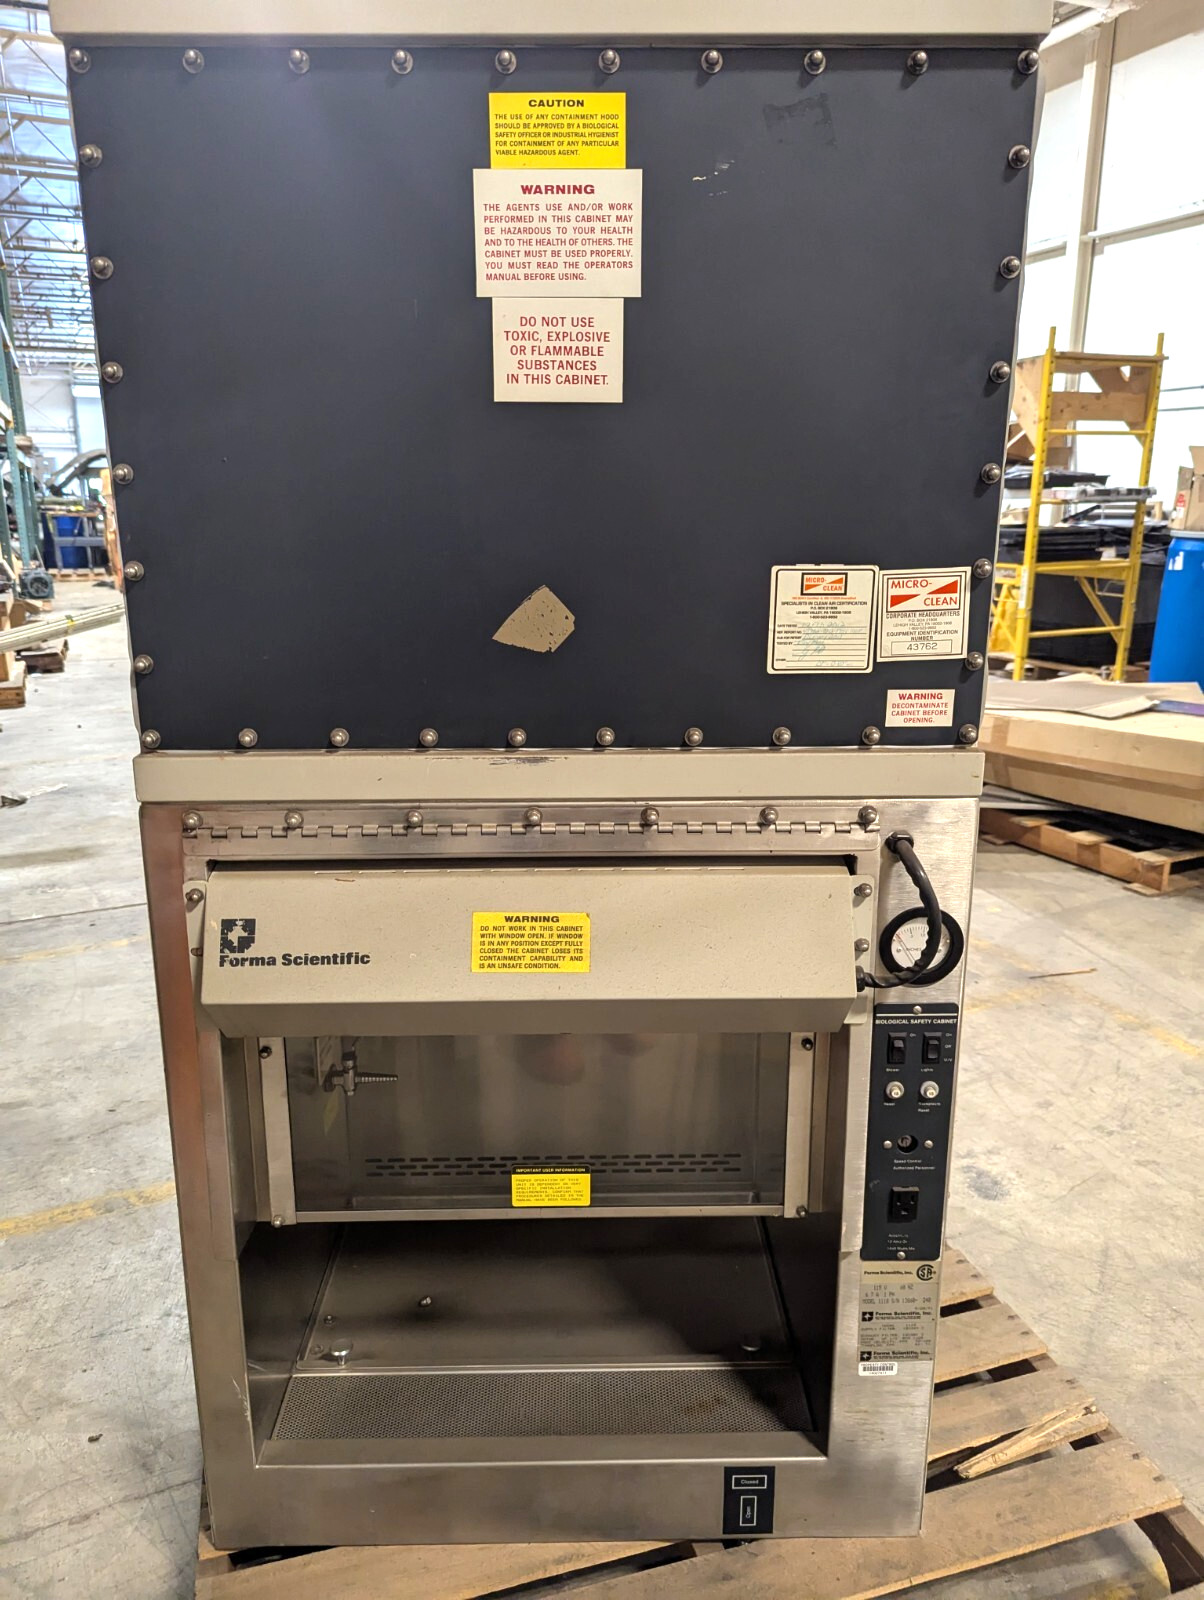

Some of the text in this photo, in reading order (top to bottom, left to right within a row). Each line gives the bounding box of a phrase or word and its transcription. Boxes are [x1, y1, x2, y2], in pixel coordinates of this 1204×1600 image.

[528, 99, 584, 107] CAUTION
[521, 185, 595, 195] WARNING
[506, 203, 539, 211] AGENTS
[546, 203, 562, 211] USE
[568, 203, 603, 211] AND/OR
[609, 203, 633, 211] WORK
[539, 215, 547, 223] IN
[552, 215, 571, 223] THIS
[575, 215, 611, 223] CABINET
[616, 215, 633, 223] MAY
[485, 227, 495, 235] BE
[485, 238, 633, 246] AND TO THE HEALTH OF OTHERS. THE
[485, 250, 633, 258] CABINET MUST BE USED PROPERLY.
[485, 261, 633, 269] YOU MUST READ THE OPERATORS
[486, 273, 586, 281] MANUAL BEFORE USING.
[520, 317, 595, 327] DO NOT USE
[504, 331, 610, 343] TOXIC, EXPLOSIVE
[510, 345, 604, 356] OR FLAMMABLE
[517, 360, 597, 370] SUBSTANCES
[507, 374, 609, 385] IN THIS CABINET.
[891, 579, 932, 589] MICRO-
[924, 597, 958, 606] CLEAN
[219, 952, 370, 967] Forma Scientific
